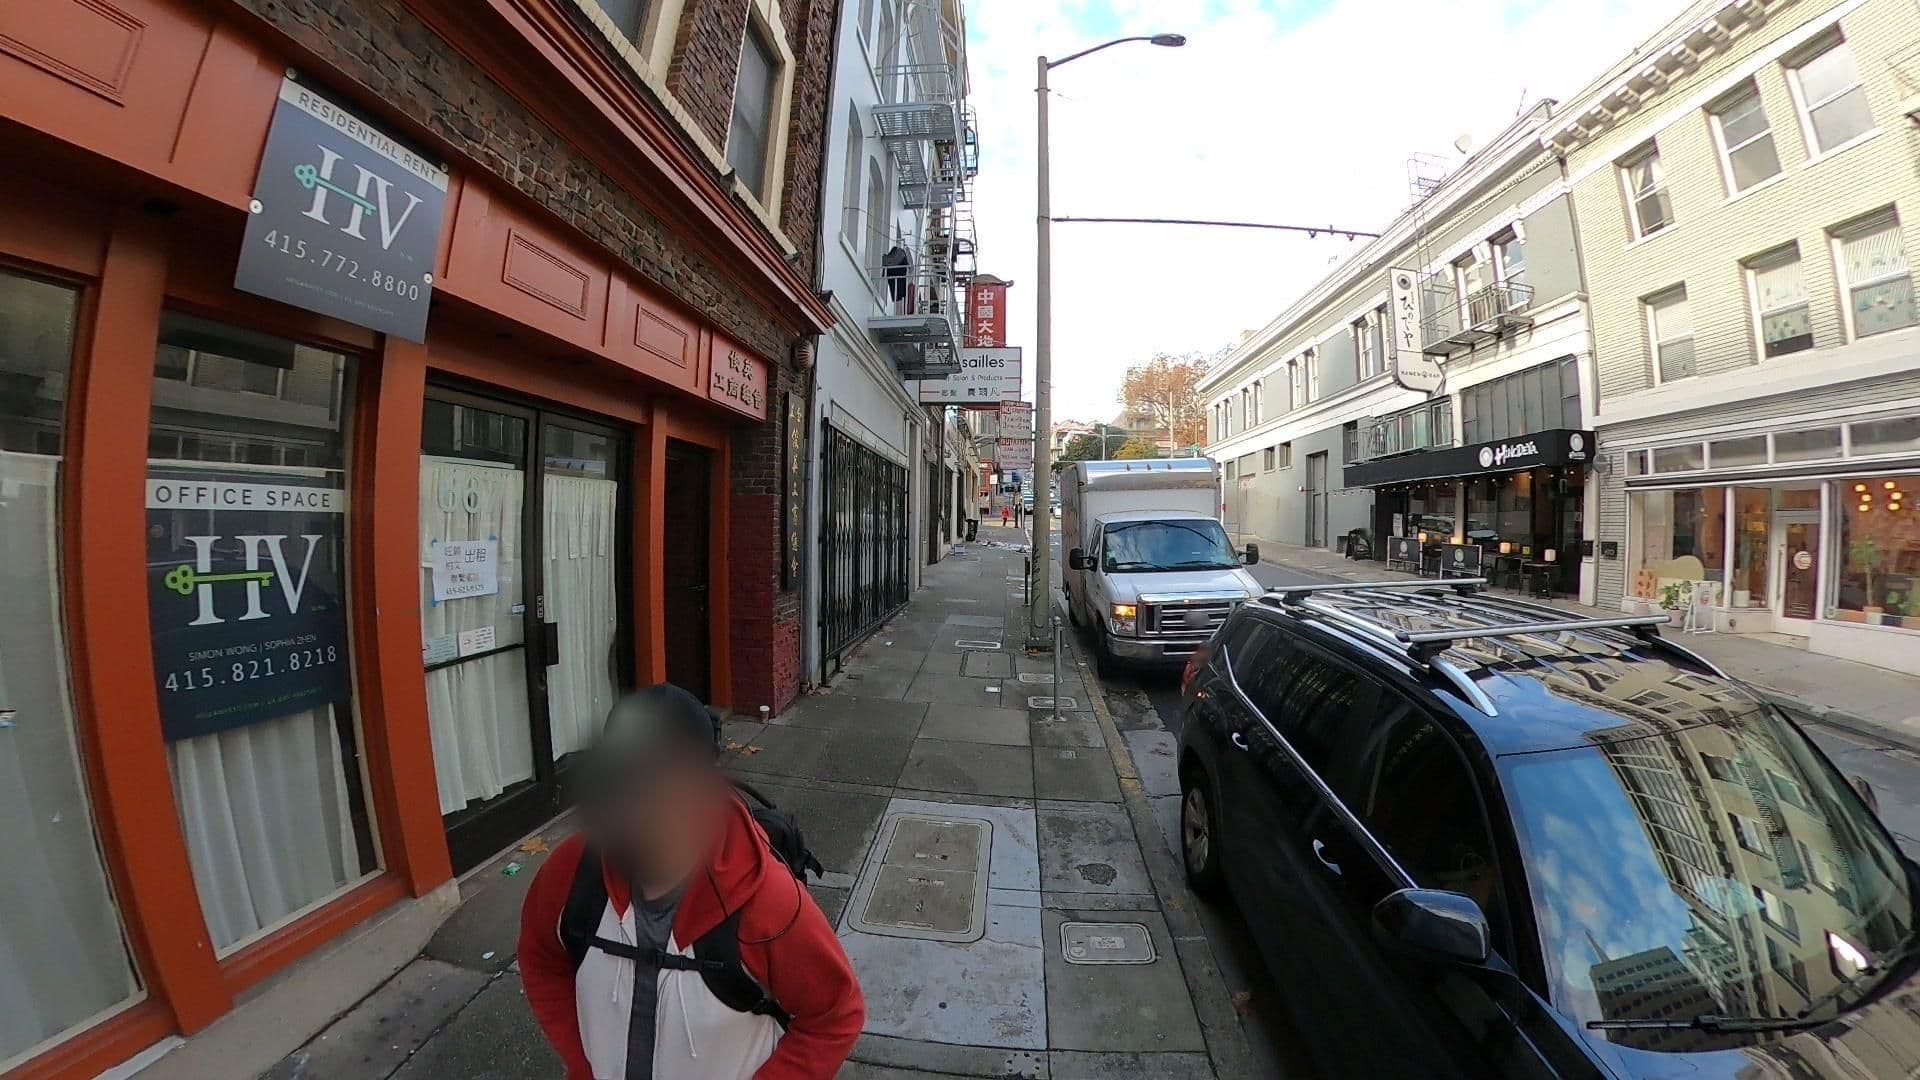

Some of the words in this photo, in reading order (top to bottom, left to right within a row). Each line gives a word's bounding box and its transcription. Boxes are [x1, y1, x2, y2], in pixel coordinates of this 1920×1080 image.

[299, 92, 398, 160] RESIDENTIAL
[403, 154, 438, 180] RENT
[264, 229, 419, 301] 415.772.8800
[156, 485, 253, 506] OFFICE
[266, 490, 331, 508] SPACE
[464, 548, 487, 563] 出租
[188, 648, 223, 662] SIMON
[226, 644, 258, 657] WONG
[265, 638, 297, 650] SOPHIA
[297, 633, 317, 645] ZHEN
[165, 646, 337, 692] 415.821.8218
